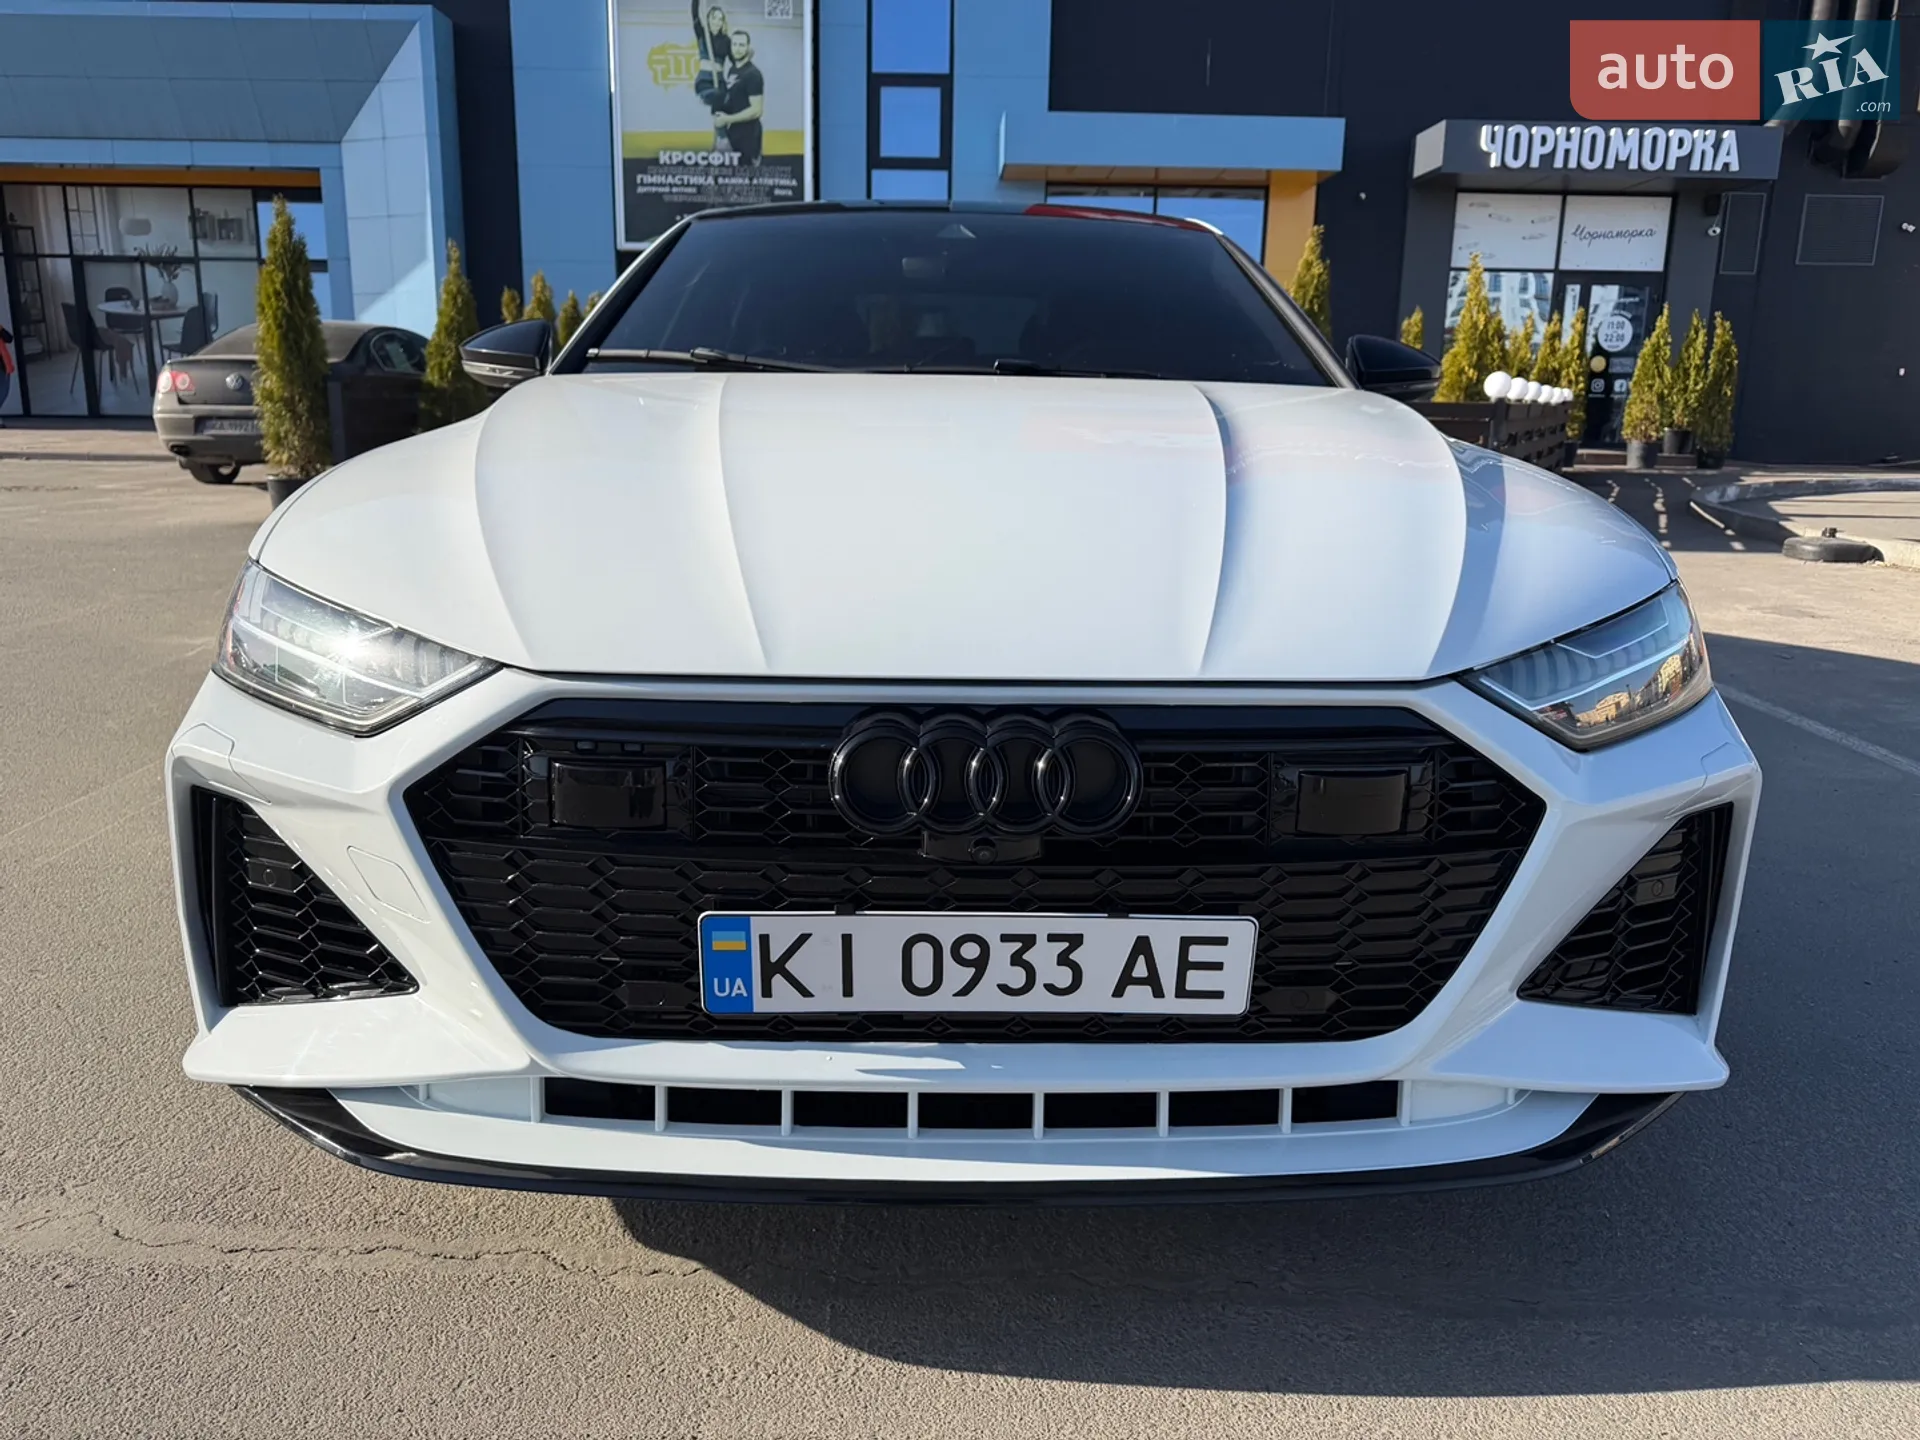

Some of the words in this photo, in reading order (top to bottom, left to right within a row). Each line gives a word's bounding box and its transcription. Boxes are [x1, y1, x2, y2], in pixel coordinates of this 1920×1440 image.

[659, 150, 742, 166] КРОСФІТ
[1479, 124, 1740, 172] ЧОРНОМОРКА
[758, 933, 855, 999] KI
[901, 933, 1084, 998] 0933
[1110, 935, 1229, 999] AE
[713, 977, 749, 998] UA
